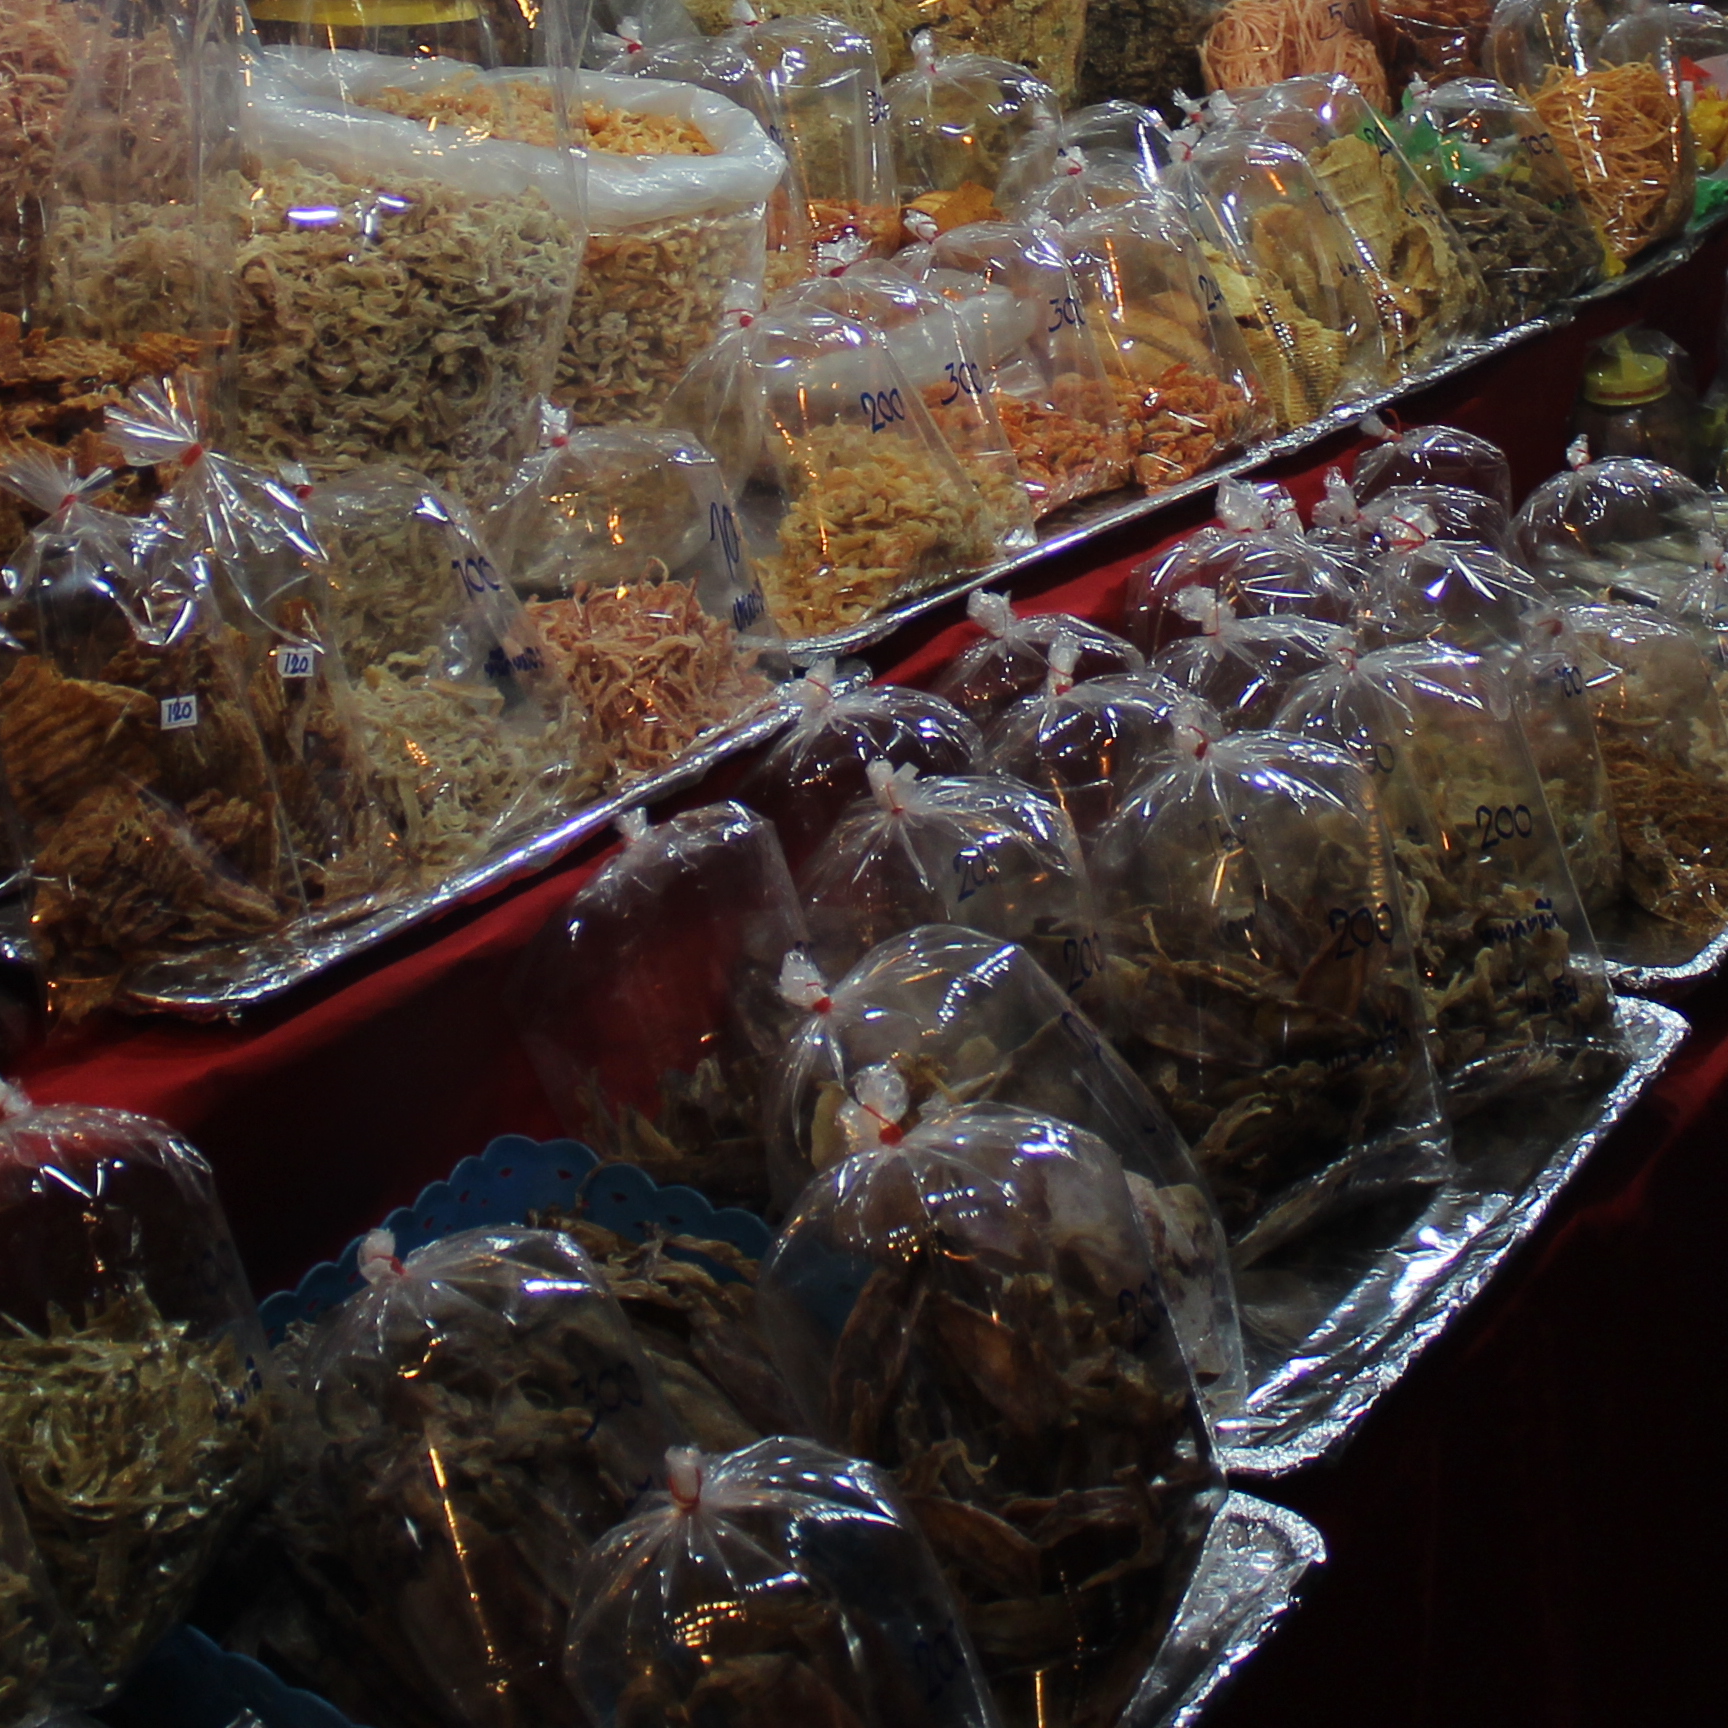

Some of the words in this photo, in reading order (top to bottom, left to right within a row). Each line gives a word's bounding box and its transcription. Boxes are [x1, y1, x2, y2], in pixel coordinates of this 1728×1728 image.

[860, 388, 906, 435] 200
[285, 652, 309, 674] 120
[167, 701, 192, 721] 120
[1475, 803, 1533, 851] 200
[1328, 901, 1395, 962] 200
